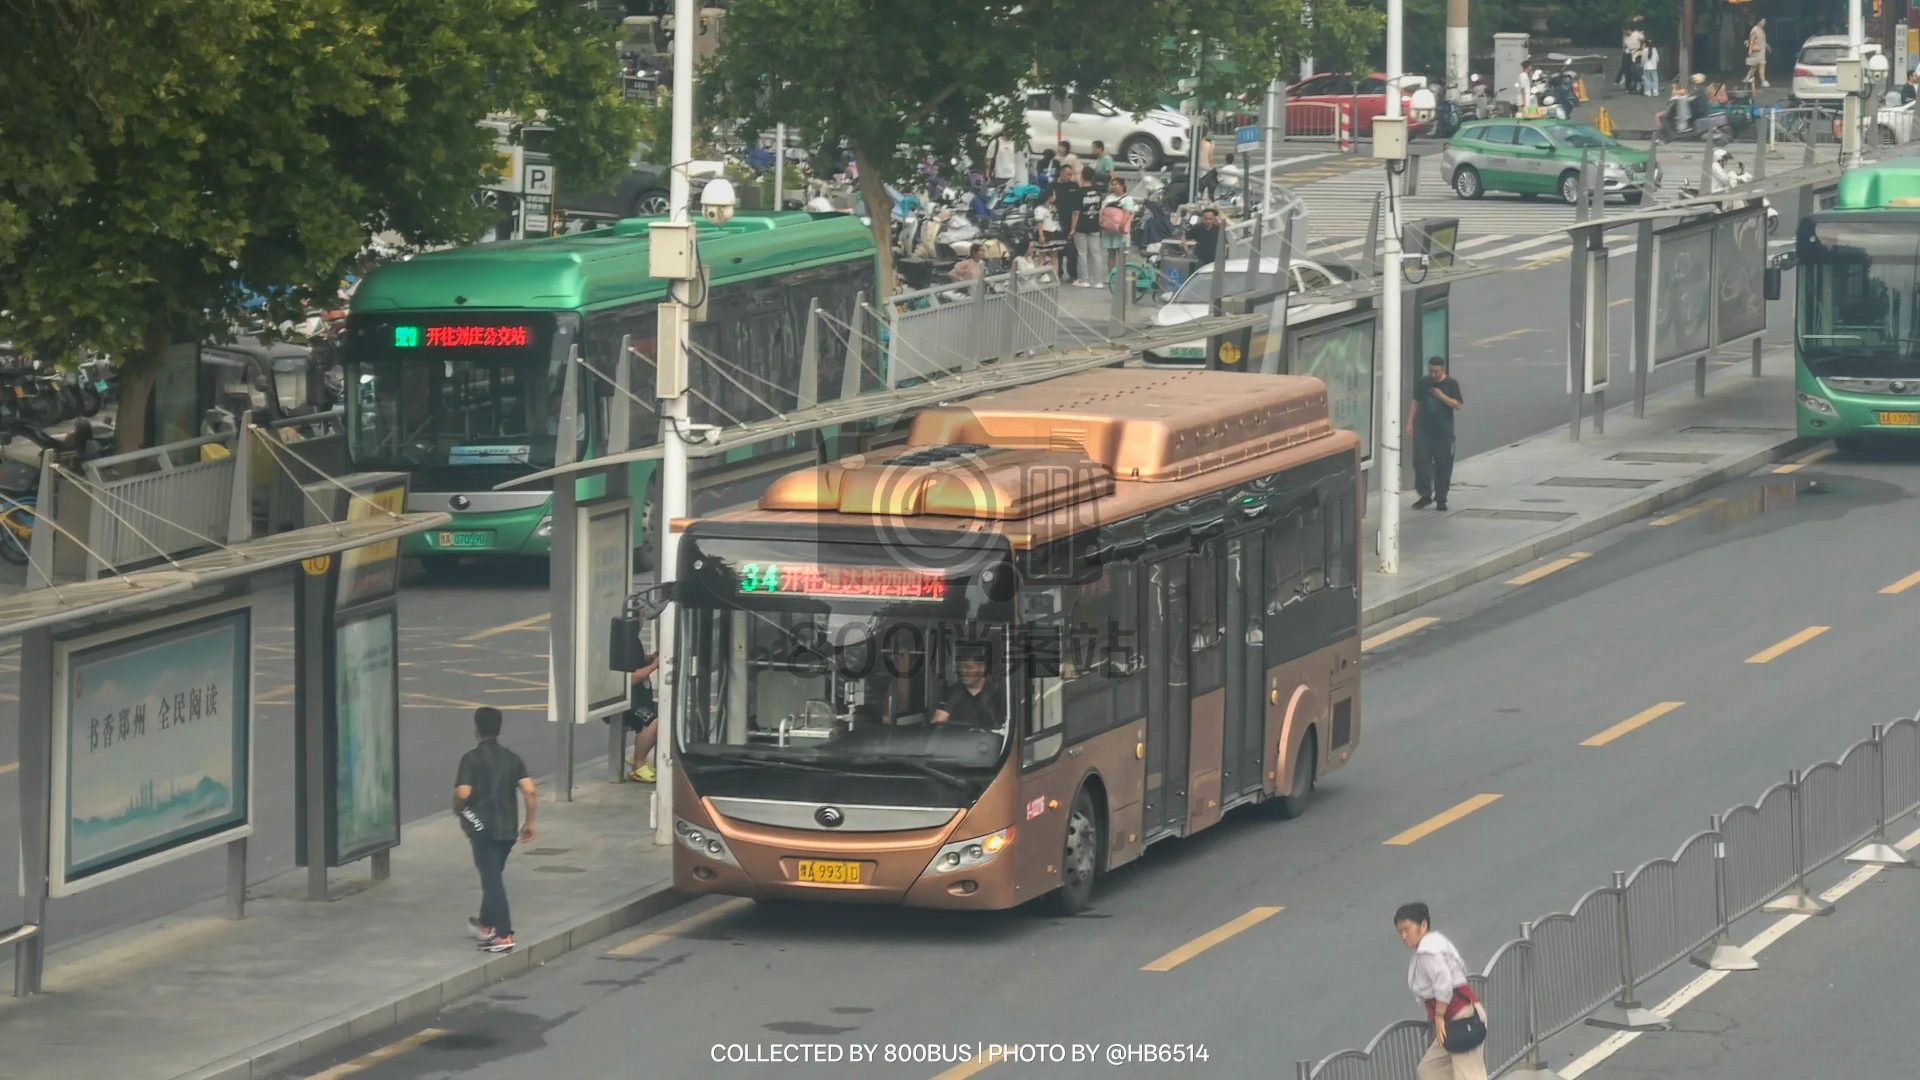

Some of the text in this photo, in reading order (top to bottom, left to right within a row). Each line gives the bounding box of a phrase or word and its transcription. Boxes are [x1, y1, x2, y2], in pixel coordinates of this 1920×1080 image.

[531, 169, 546, 190] P
[741, 563, 778, 593] 34
[88, 683, 218, 753] 书香郑州 全民阅读
